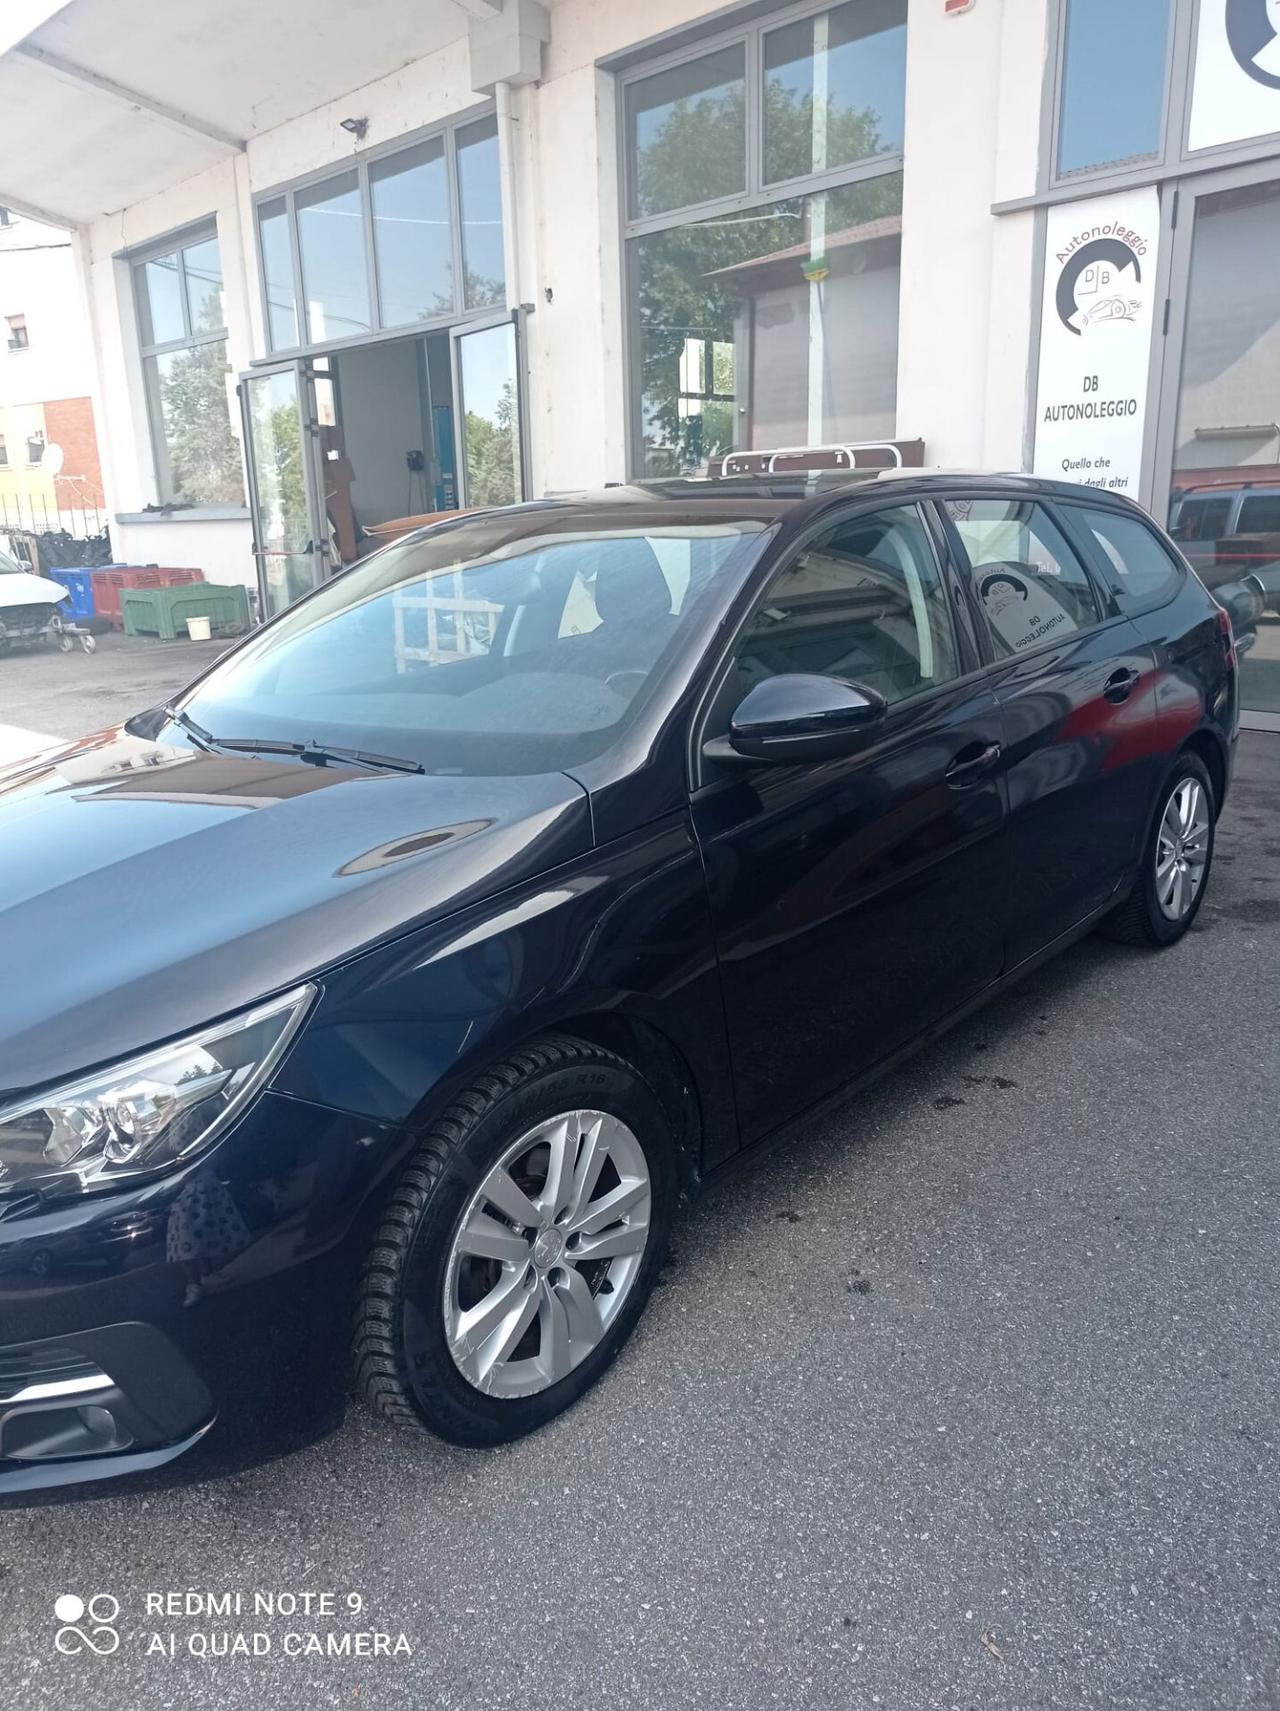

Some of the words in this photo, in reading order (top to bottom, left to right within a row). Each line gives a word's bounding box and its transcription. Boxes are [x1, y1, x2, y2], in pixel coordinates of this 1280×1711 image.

[1055, 220, 1147, 264] Autonoleggio
[1083, 375, 1099, 393] DB
[1044, 399, 1138, 423] AUTONOLEGGIO
[1061, 458, 1092, 472] Quello
[1094, 456, 1111, 468] che
[1108, 476, 1129, 488] altri
